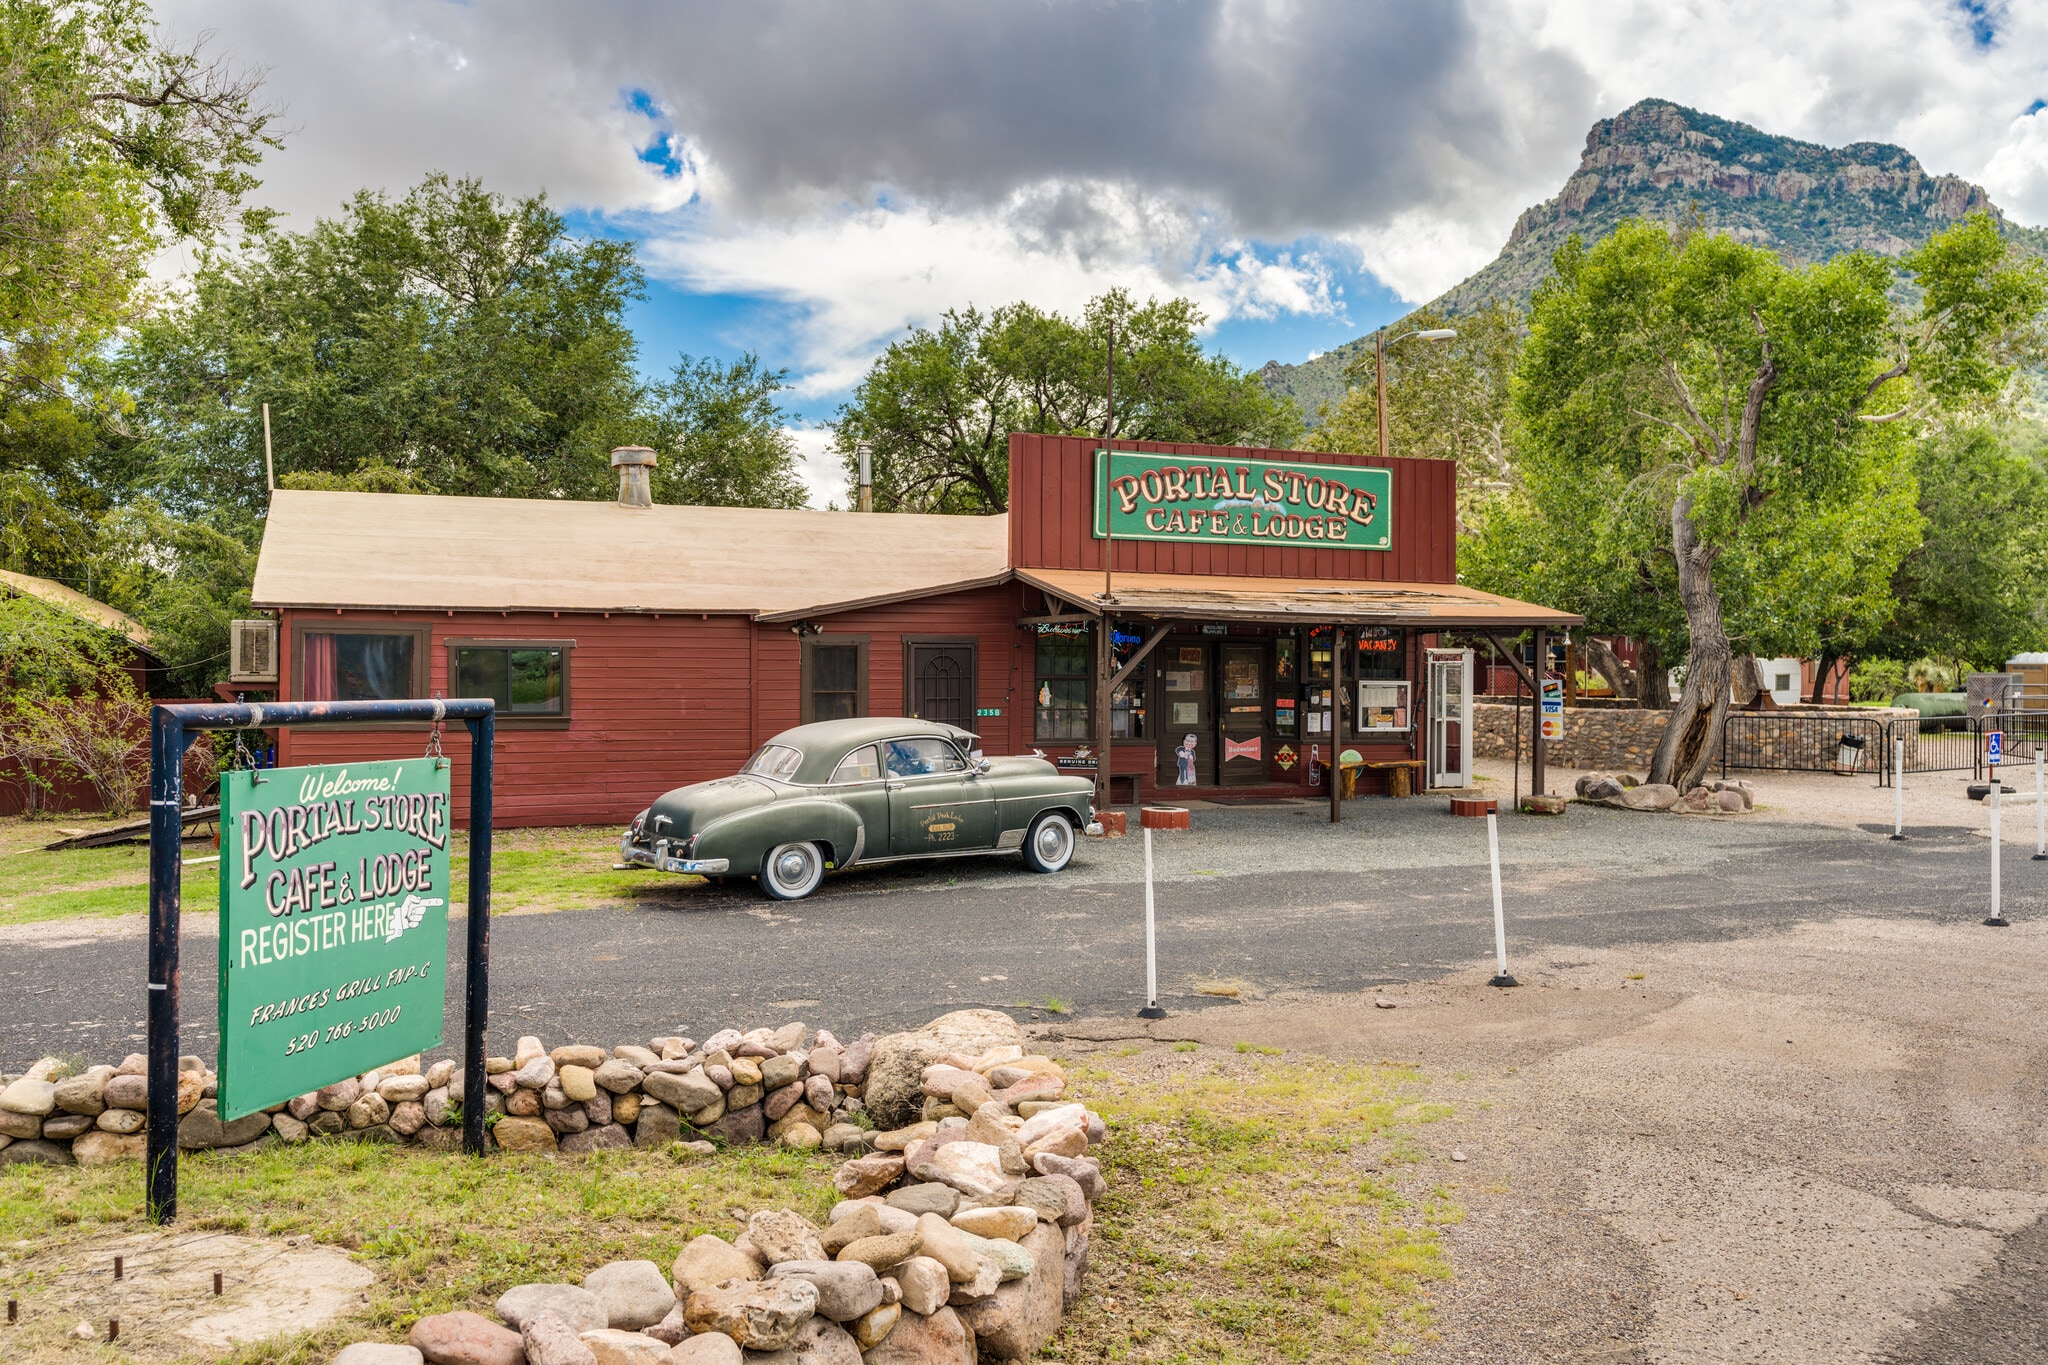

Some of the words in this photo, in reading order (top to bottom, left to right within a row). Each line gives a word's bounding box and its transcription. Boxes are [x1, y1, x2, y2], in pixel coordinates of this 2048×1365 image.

[1112, 466, 1257, 513] PORTAL
[1264, 468, 1377, 526] STORE
[1145, 508, 1229, 535] CAFE
[1233, 516, 1247, 535] &
[1251, 512, 1348, 540] LODGE
[1110, 631, 1141, 644] Corona
[1358, 639, 1397, 651] VACANCY
[299, 767, 402, 803] Welcome!
[240, 799, 362, 890] PORTAL
[364, 792, 447, 851] STORE
[938, 832, 954, 842] 2223
[266, 861, 336, 917] CAFE
[339, 872, 355, 904] &
[359, 848, 432, 901] LODGE
[241, 912, 346, 968] REGISTER
[352, 902, 396, 943] HERE
[250, 988, 331, 1026] FRANCES
[335, 975, 381, 1002] GRILL
[386, 961, 431, 988] FNP-C
[285, 1030, 319, 1056] 520
[325, 1005, 401, 1043] 766-5000
